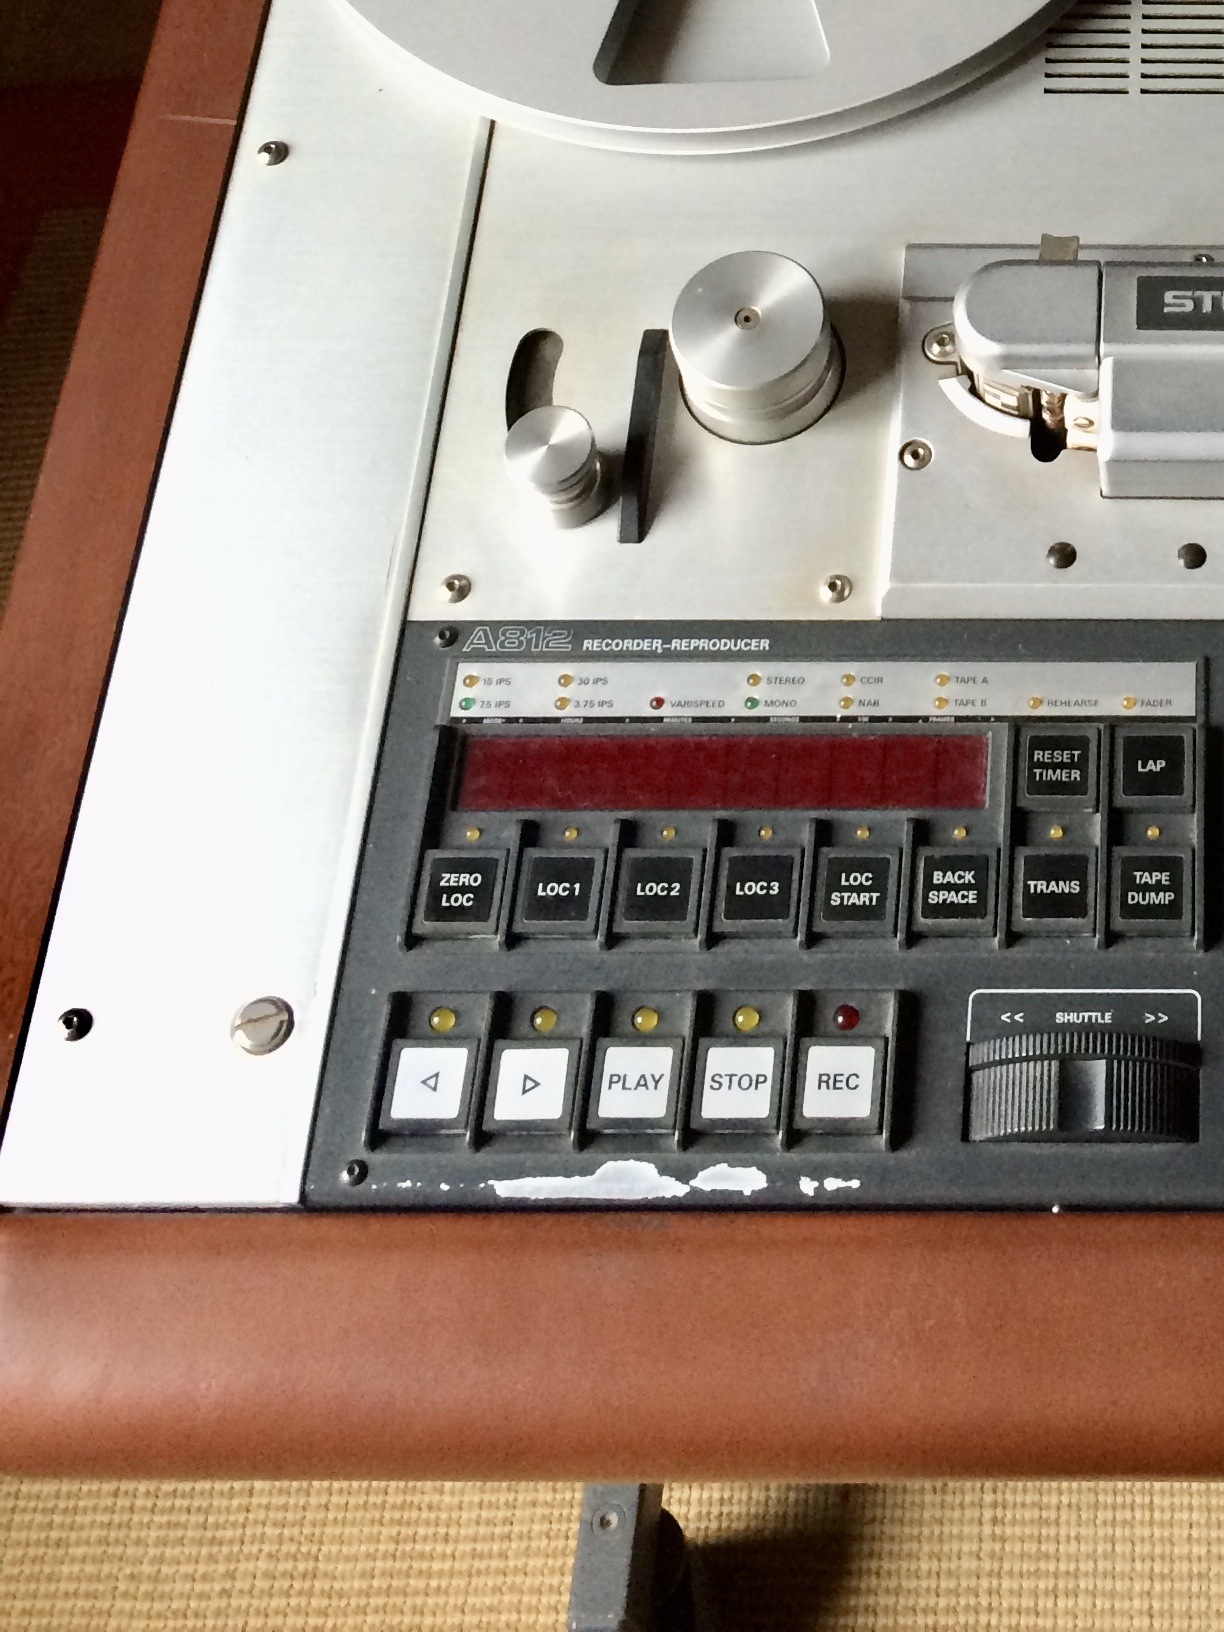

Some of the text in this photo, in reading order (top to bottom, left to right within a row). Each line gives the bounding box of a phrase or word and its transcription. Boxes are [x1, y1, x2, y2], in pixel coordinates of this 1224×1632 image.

[462, 625, 574, 653] A812
[765, 676, 806, 685] STEREO
[859, 676, 884, 685] CCIR
[954, 676, 989, 685] TAPE A
[669, 699, 726, 709] VARISPEED
[763, 699, 797, 708] MONO
[858, 699, 880, 708] NAB
[953, 699, 978, 708] TAPE
[1046, 699, 1099, 708] REHEARSE
[1140, 699, 1173, 708] FADER
[1033, 750, 1082, 763] RESET
[1137, 759, 1167, 772] LAP
[1033, 769, 1081, 782] TIMER
[440, 873, 482, 887] ZERO
[841, 872, 873, 887] LOC
[932, 871, 976, 885] BACK
[1133, 872, 1171, 886] TAPE
[1027, 880, 1081, 895] TRANS
[441, 893, 474, 907] LOC
[830, 892, 880, 907] START
[928, 890, 978, 905] SPACE
[1128, 892, 1175, 906] DUMP
[1055, 1011, 1113, 1024] SHUTTLE
[607, 1073, 665, 1092] PLAY
[709, 1073, 768, 1092] STOP
[817, 1072, 860, 1091] REC
